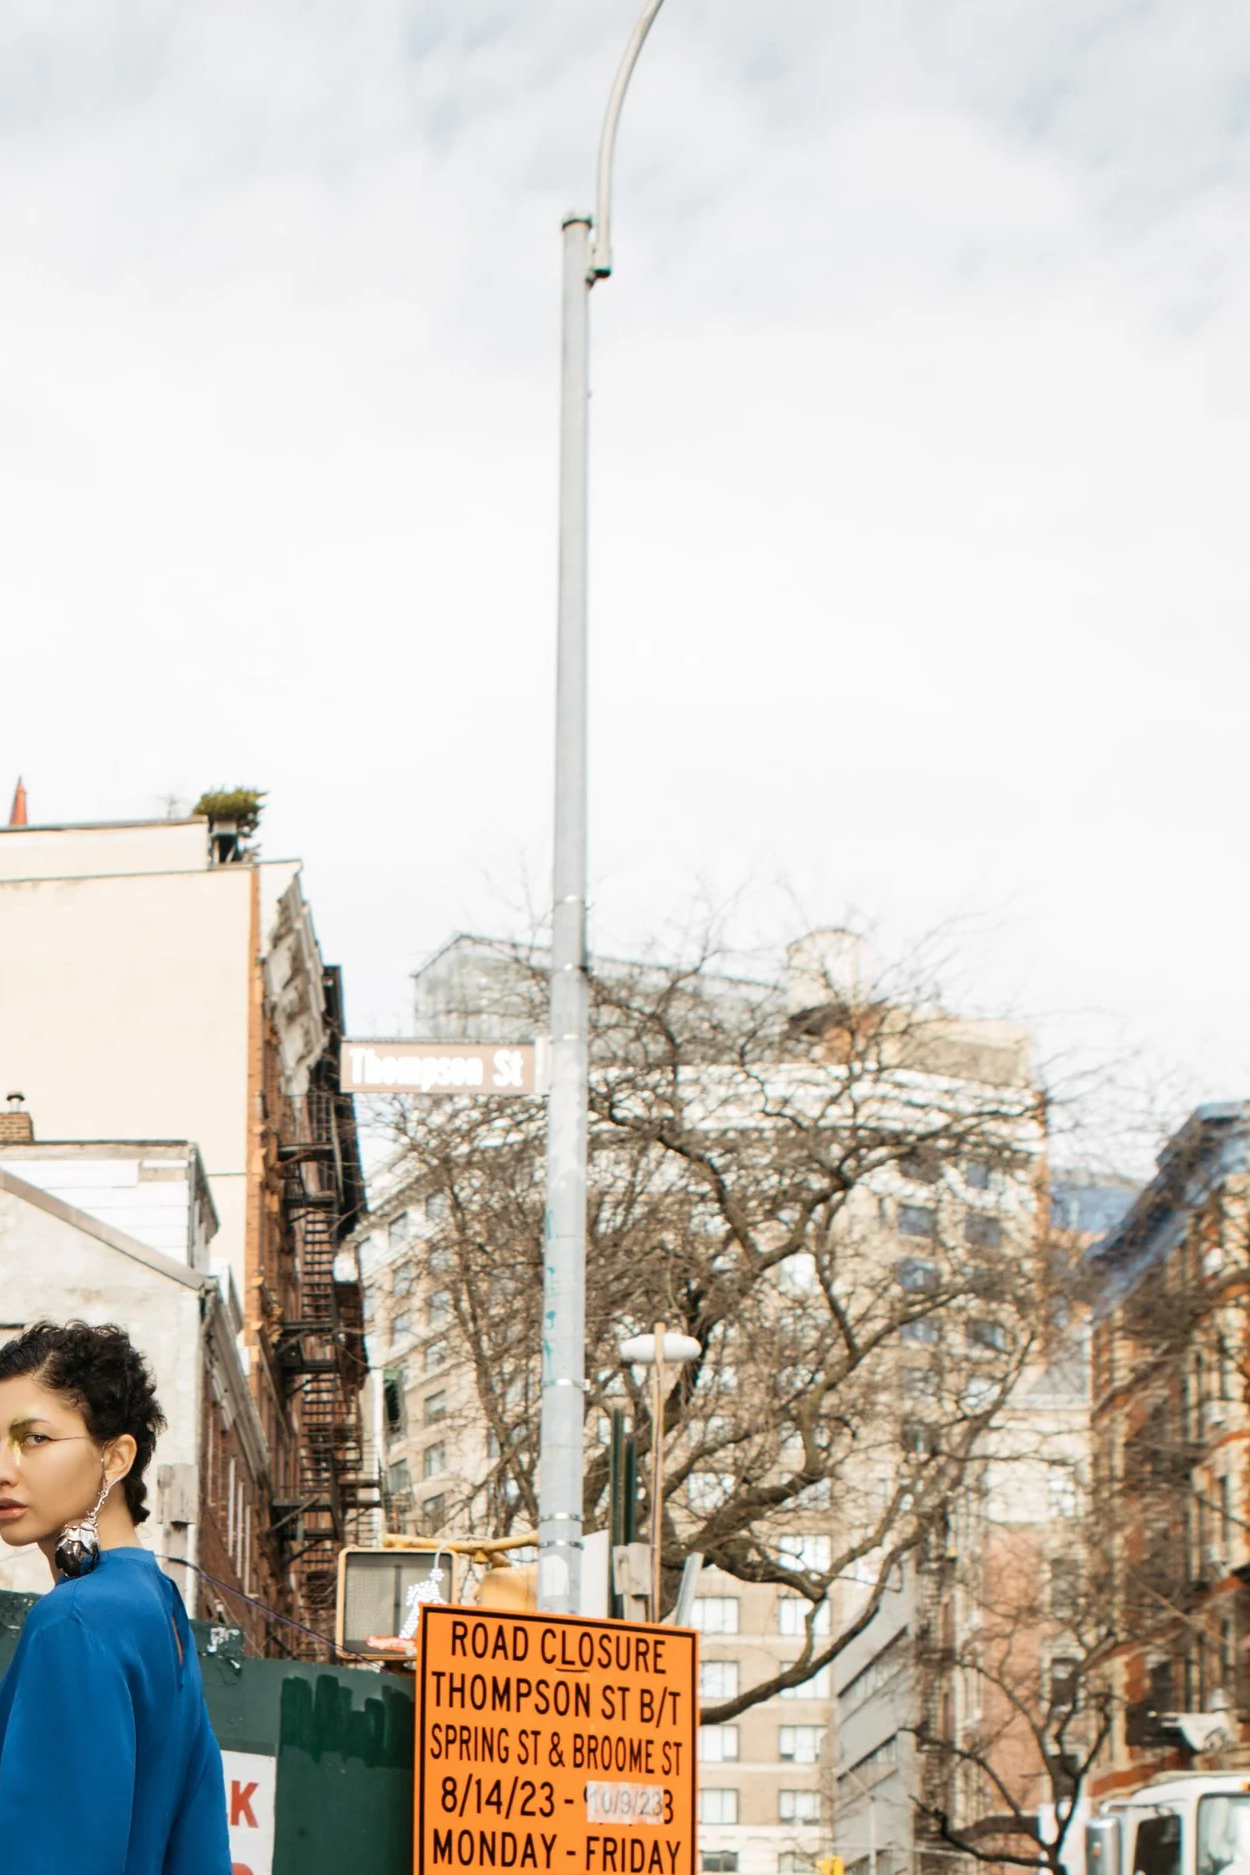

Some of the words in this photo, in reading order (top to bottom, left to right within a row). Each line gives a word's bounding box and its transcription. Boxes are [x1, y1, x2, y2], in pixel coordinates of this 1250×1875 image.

[348, 1047, 484, 1092] Thompson
[493, 1048, 524, 1087] St
[451, 1620, 528, 1661] ROAD
[540, 1630, 667, 1674] CLOSURE
[431, 1671, 591, 1718] THOMPSON
[601, 1685, 630, 1720] ST
[640, 1686, 682, 1728] B/T
[430, 1723, 509, 1764] SPRING
[517, 1729, 542, 1765] ST
[548, 1731, 565, 1767] &
[573, 1733, 655, 1774] BROOME
[661, 1741, 683, 1776] ST
[441, 1773, 555, 1819] 8/14/23
[590, 1788, 663, 1816] 10/9/23
[433, 1828, 556, 1869] MONDAY
[586, 1836, 681, 1875] FRIDAY
